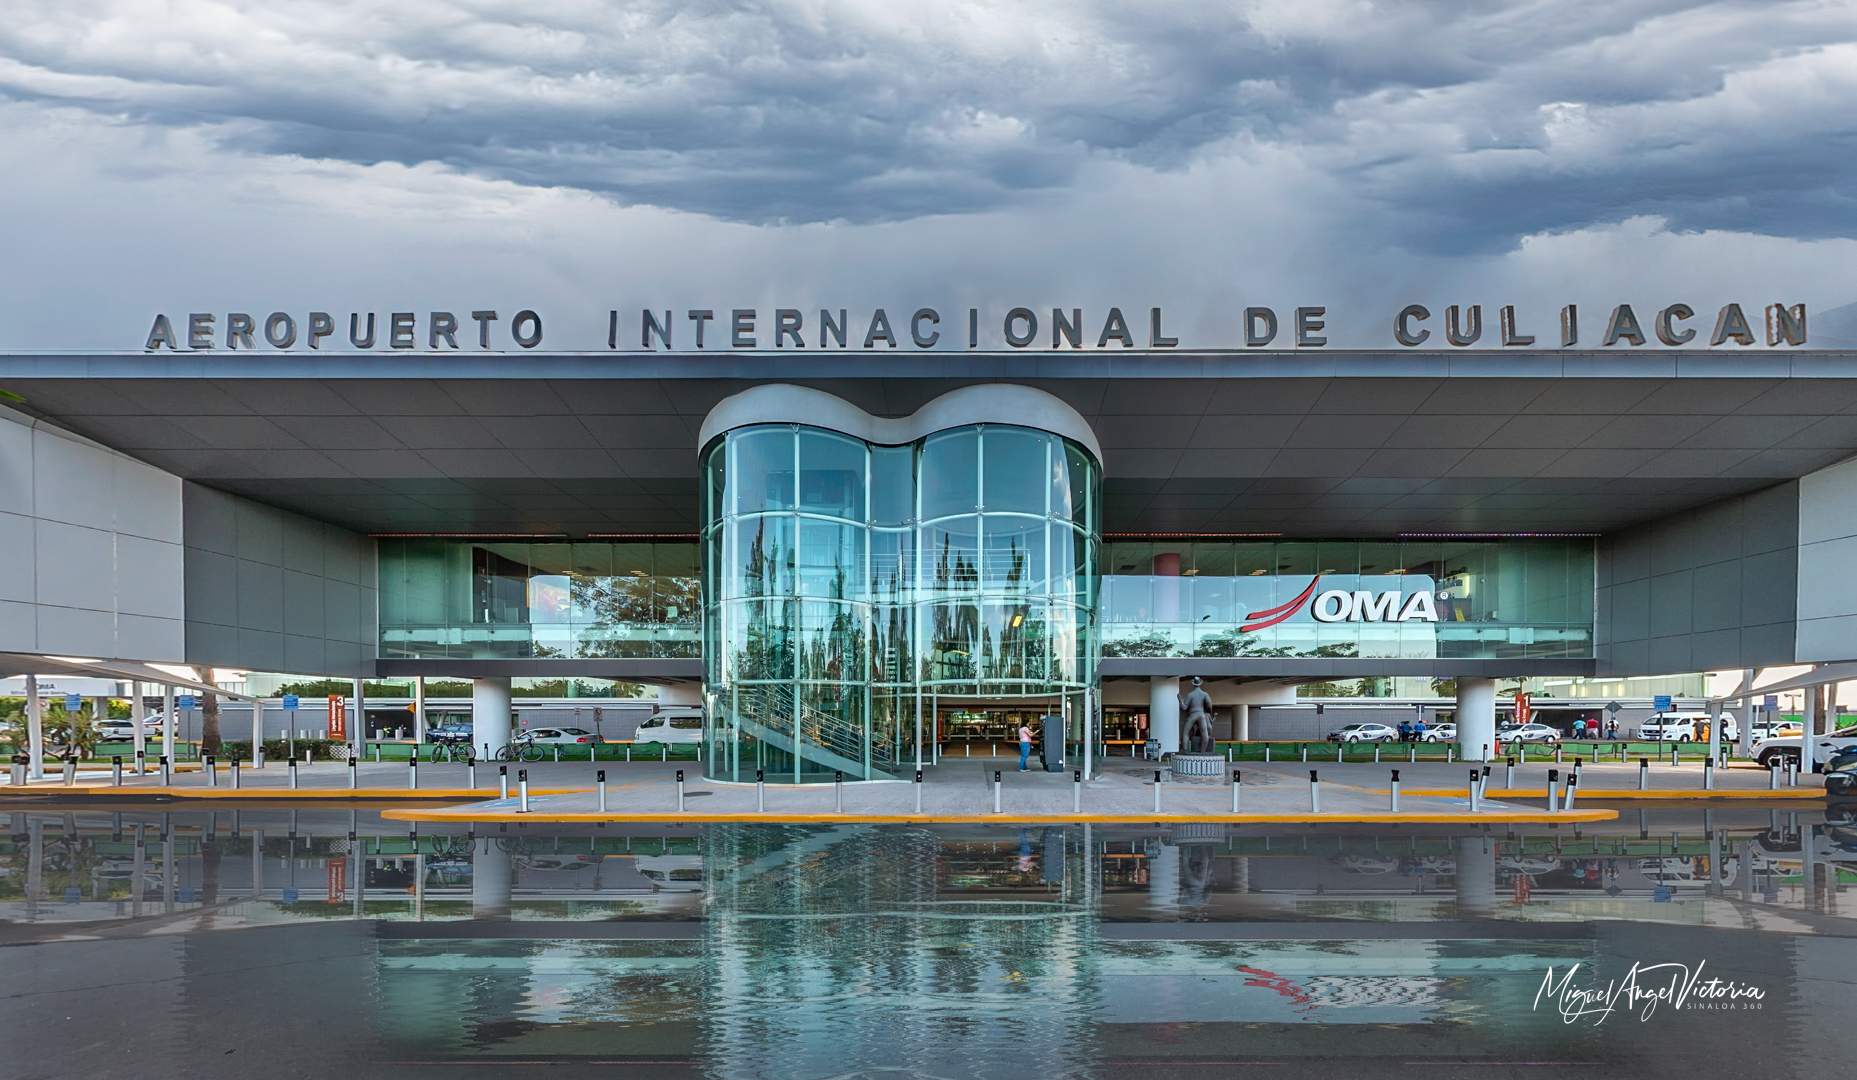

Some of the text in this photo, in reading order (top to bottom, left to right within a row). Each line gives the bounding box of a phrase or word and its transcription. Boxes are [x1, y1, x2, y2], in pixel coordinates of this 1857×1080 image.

[145, 303, 1807, 349] AEROPUERTO INTERNACIONAL DE CULIACAN
[1312, 590, 1438, 622] OMA
[336, 696, 344, 706] 3
[1523, 695, 1529, 707] 1
